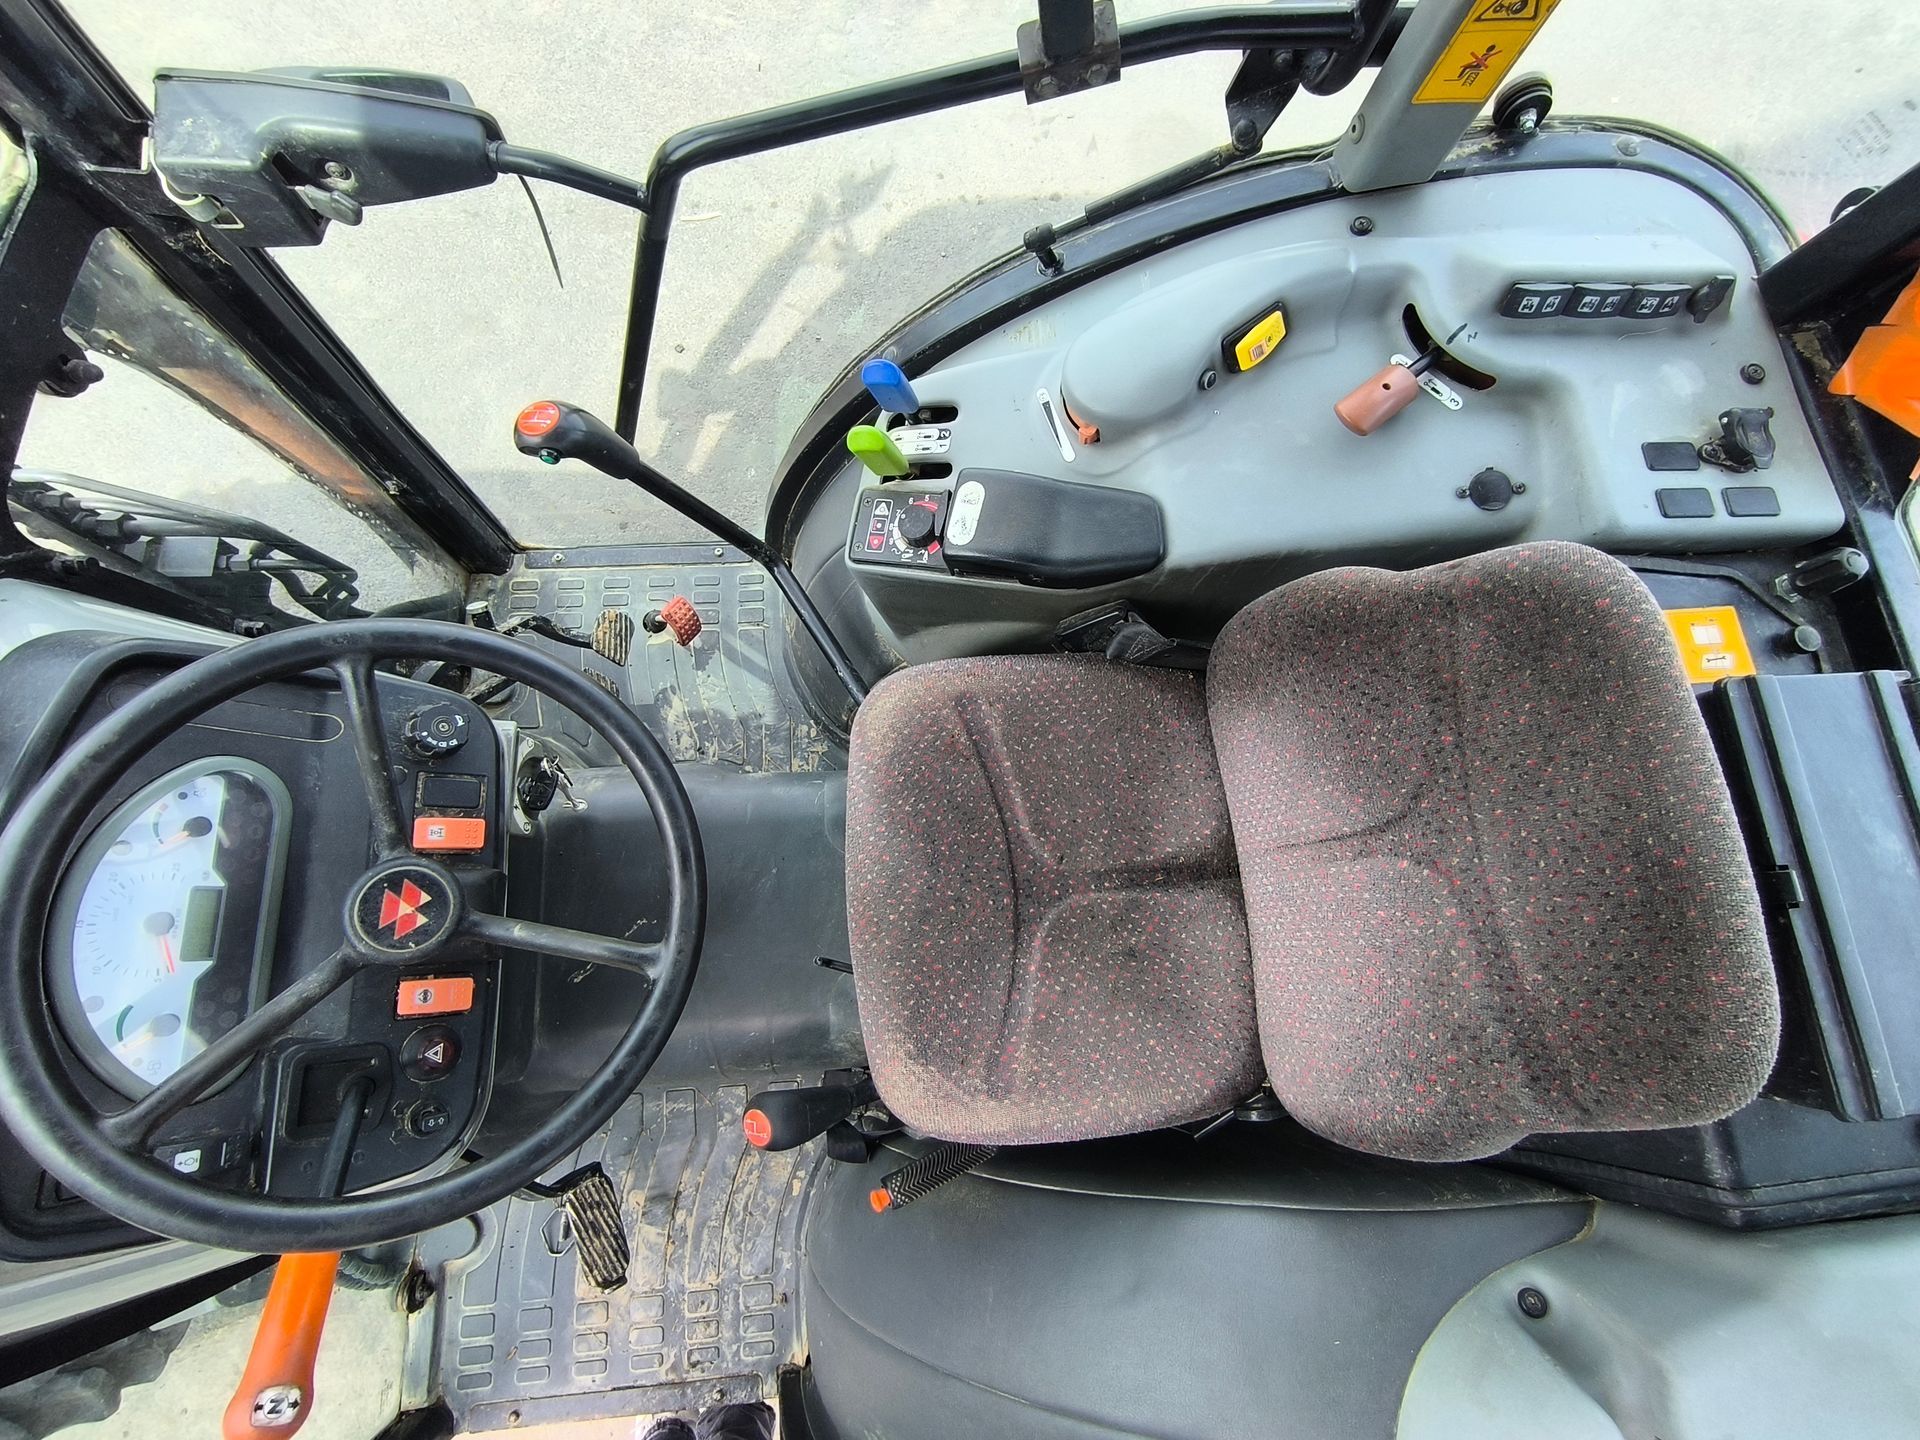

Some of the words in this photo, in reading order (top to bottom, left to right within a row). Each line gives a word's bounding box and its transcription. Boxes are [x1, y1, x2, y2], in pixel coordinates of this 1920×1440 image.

[1449, 398, 1460, 407] 3
[940, 430, 950, 438] 2
[908, 497, 914, 505] 6
[924, 494, 930, 502] 5
[75, 919, 85, 929] 15
[92, 966, 102, 976] 10
